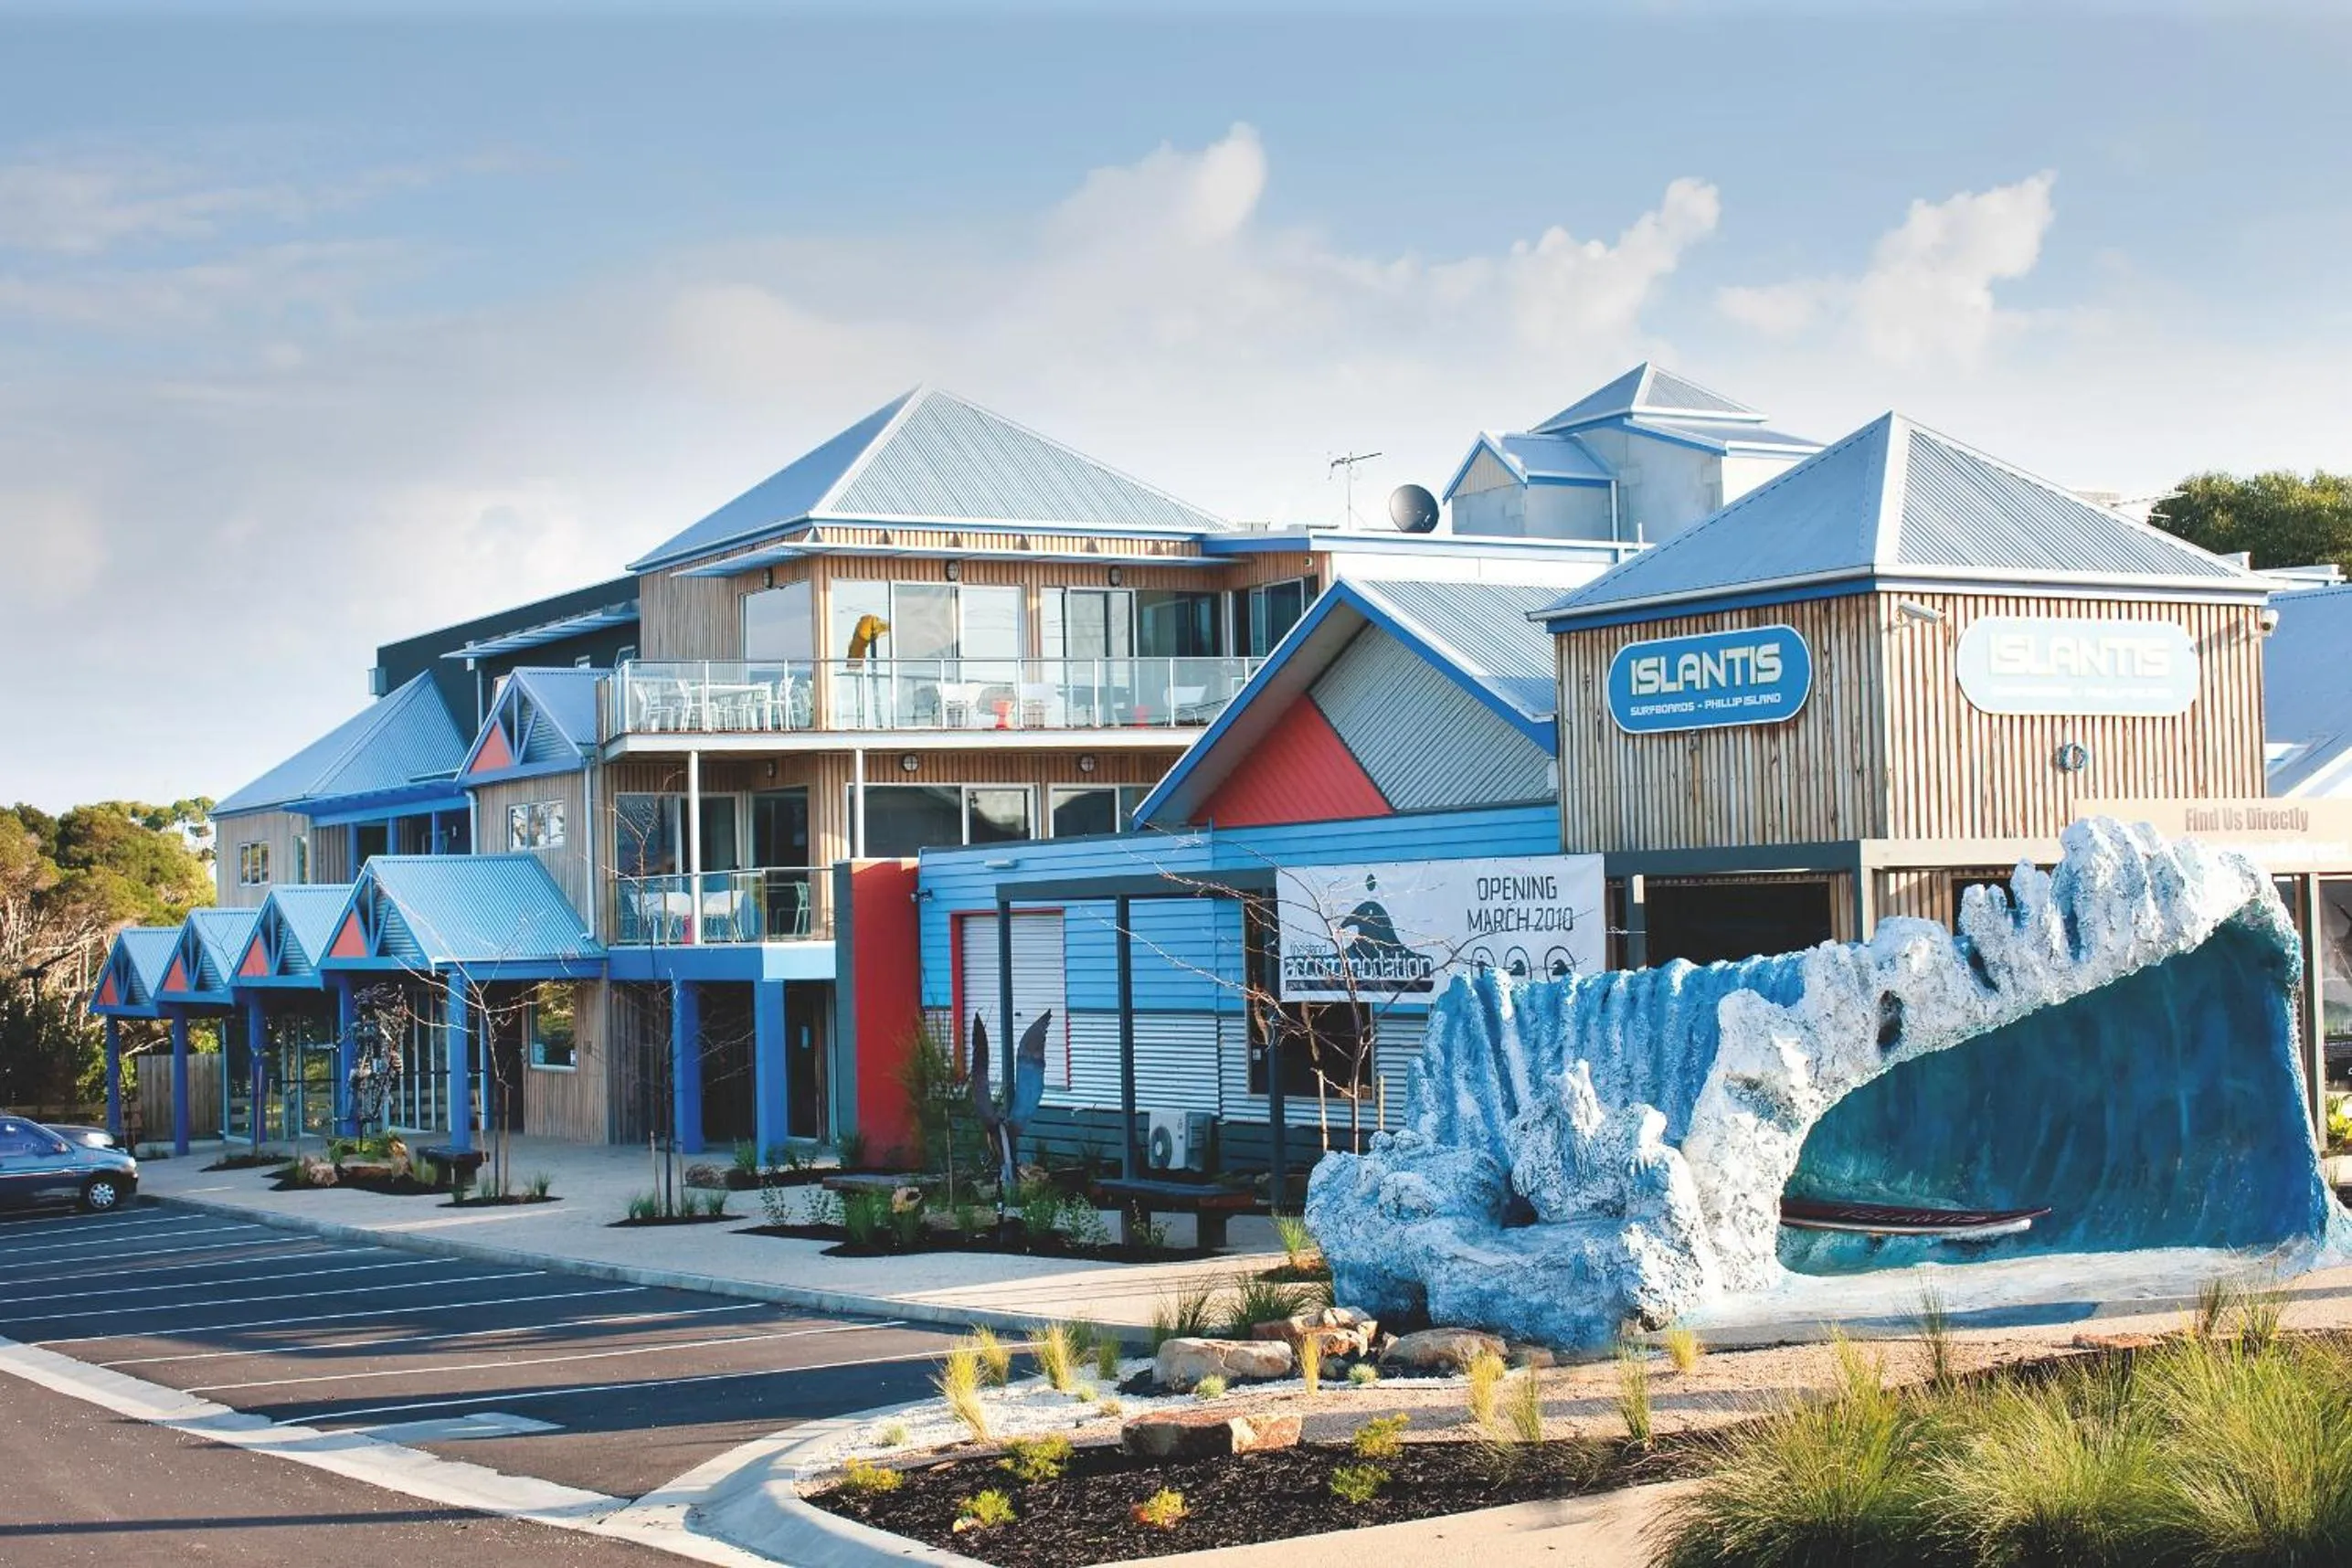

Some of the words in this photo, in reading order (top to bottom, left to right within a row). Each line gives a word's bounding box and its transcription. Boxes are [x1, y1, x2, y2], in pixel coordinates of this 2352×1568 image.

[1630, 643, 1783, 695] ISLANTIS
[1990, 634, 2172, 678] ISLANTIS
[1630, 701, 1695, 716] SURFBOARDS
[1704, 697, 1743, 709] PHILLIP
[1743, 693, 1781, 706] ISLAND
[2185, 807, 2220, 832] Find
[2222, 807, 2243, 832] Us
[2246, 807, 2309, 832] Directly
[1477, 874, 1558, 902] OPENING
[1467, 907, 1528, 933] MARCH
[1533, 906, 1574, 932] 2010
